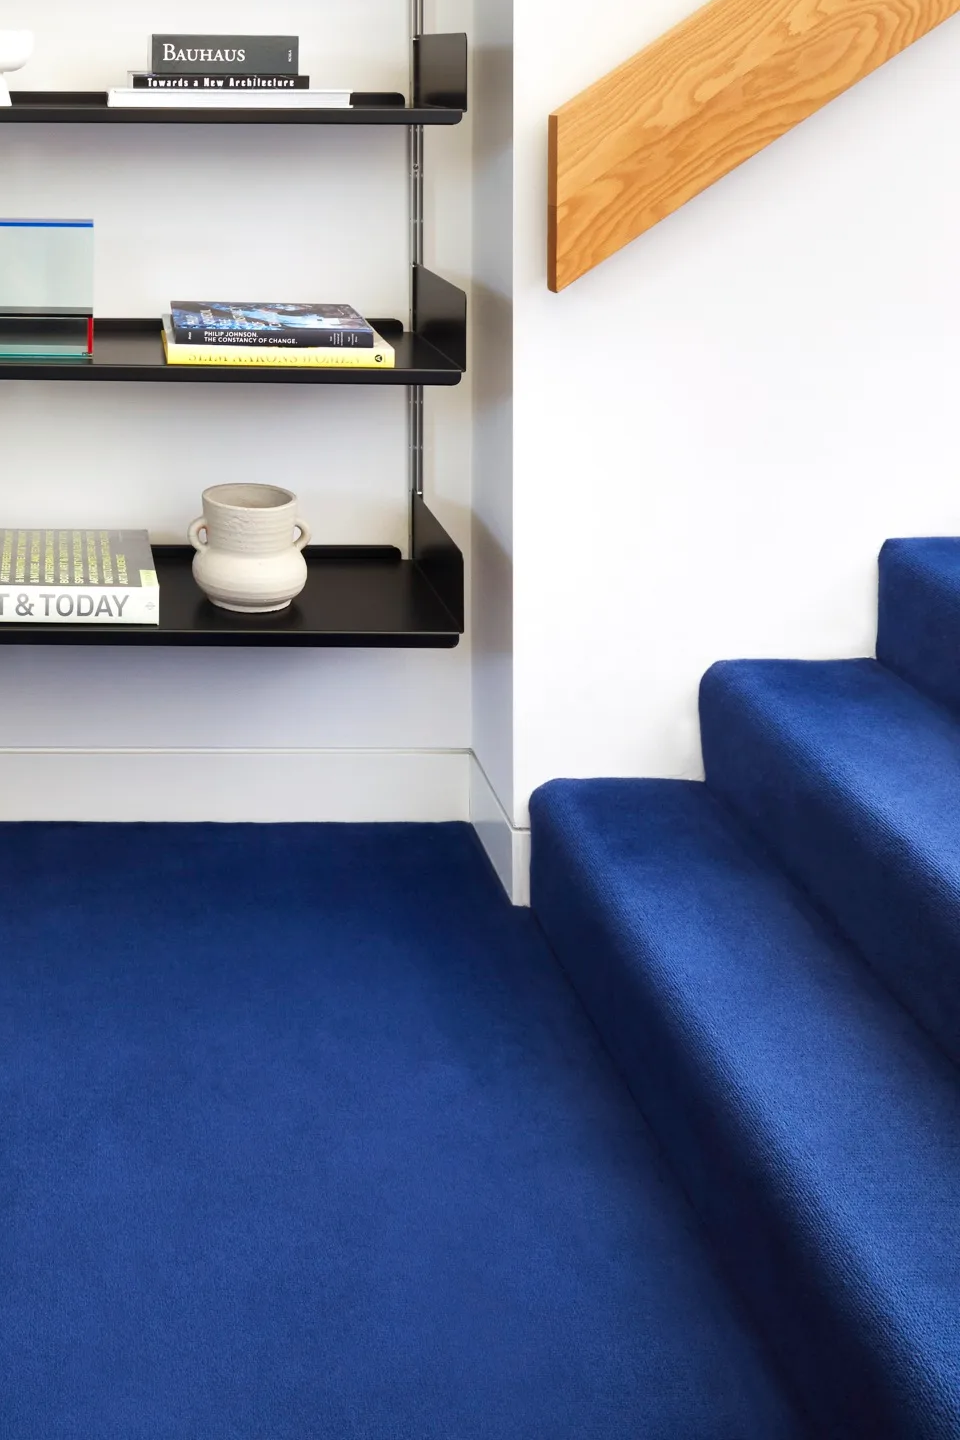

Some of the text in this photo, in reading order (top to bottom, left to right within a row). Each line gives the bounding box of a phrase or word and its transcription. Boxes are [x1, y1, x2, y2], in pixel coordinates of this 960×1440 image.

[162, 43, 246, 62] BAUHAUS
[147, 77, 296, 88] Towards a New Architecture
[203, 330, 259, 339] PHILIP JOHNSON.
[14, 592, 35, 617] &
[38, 593, 130, 618] TODAY
